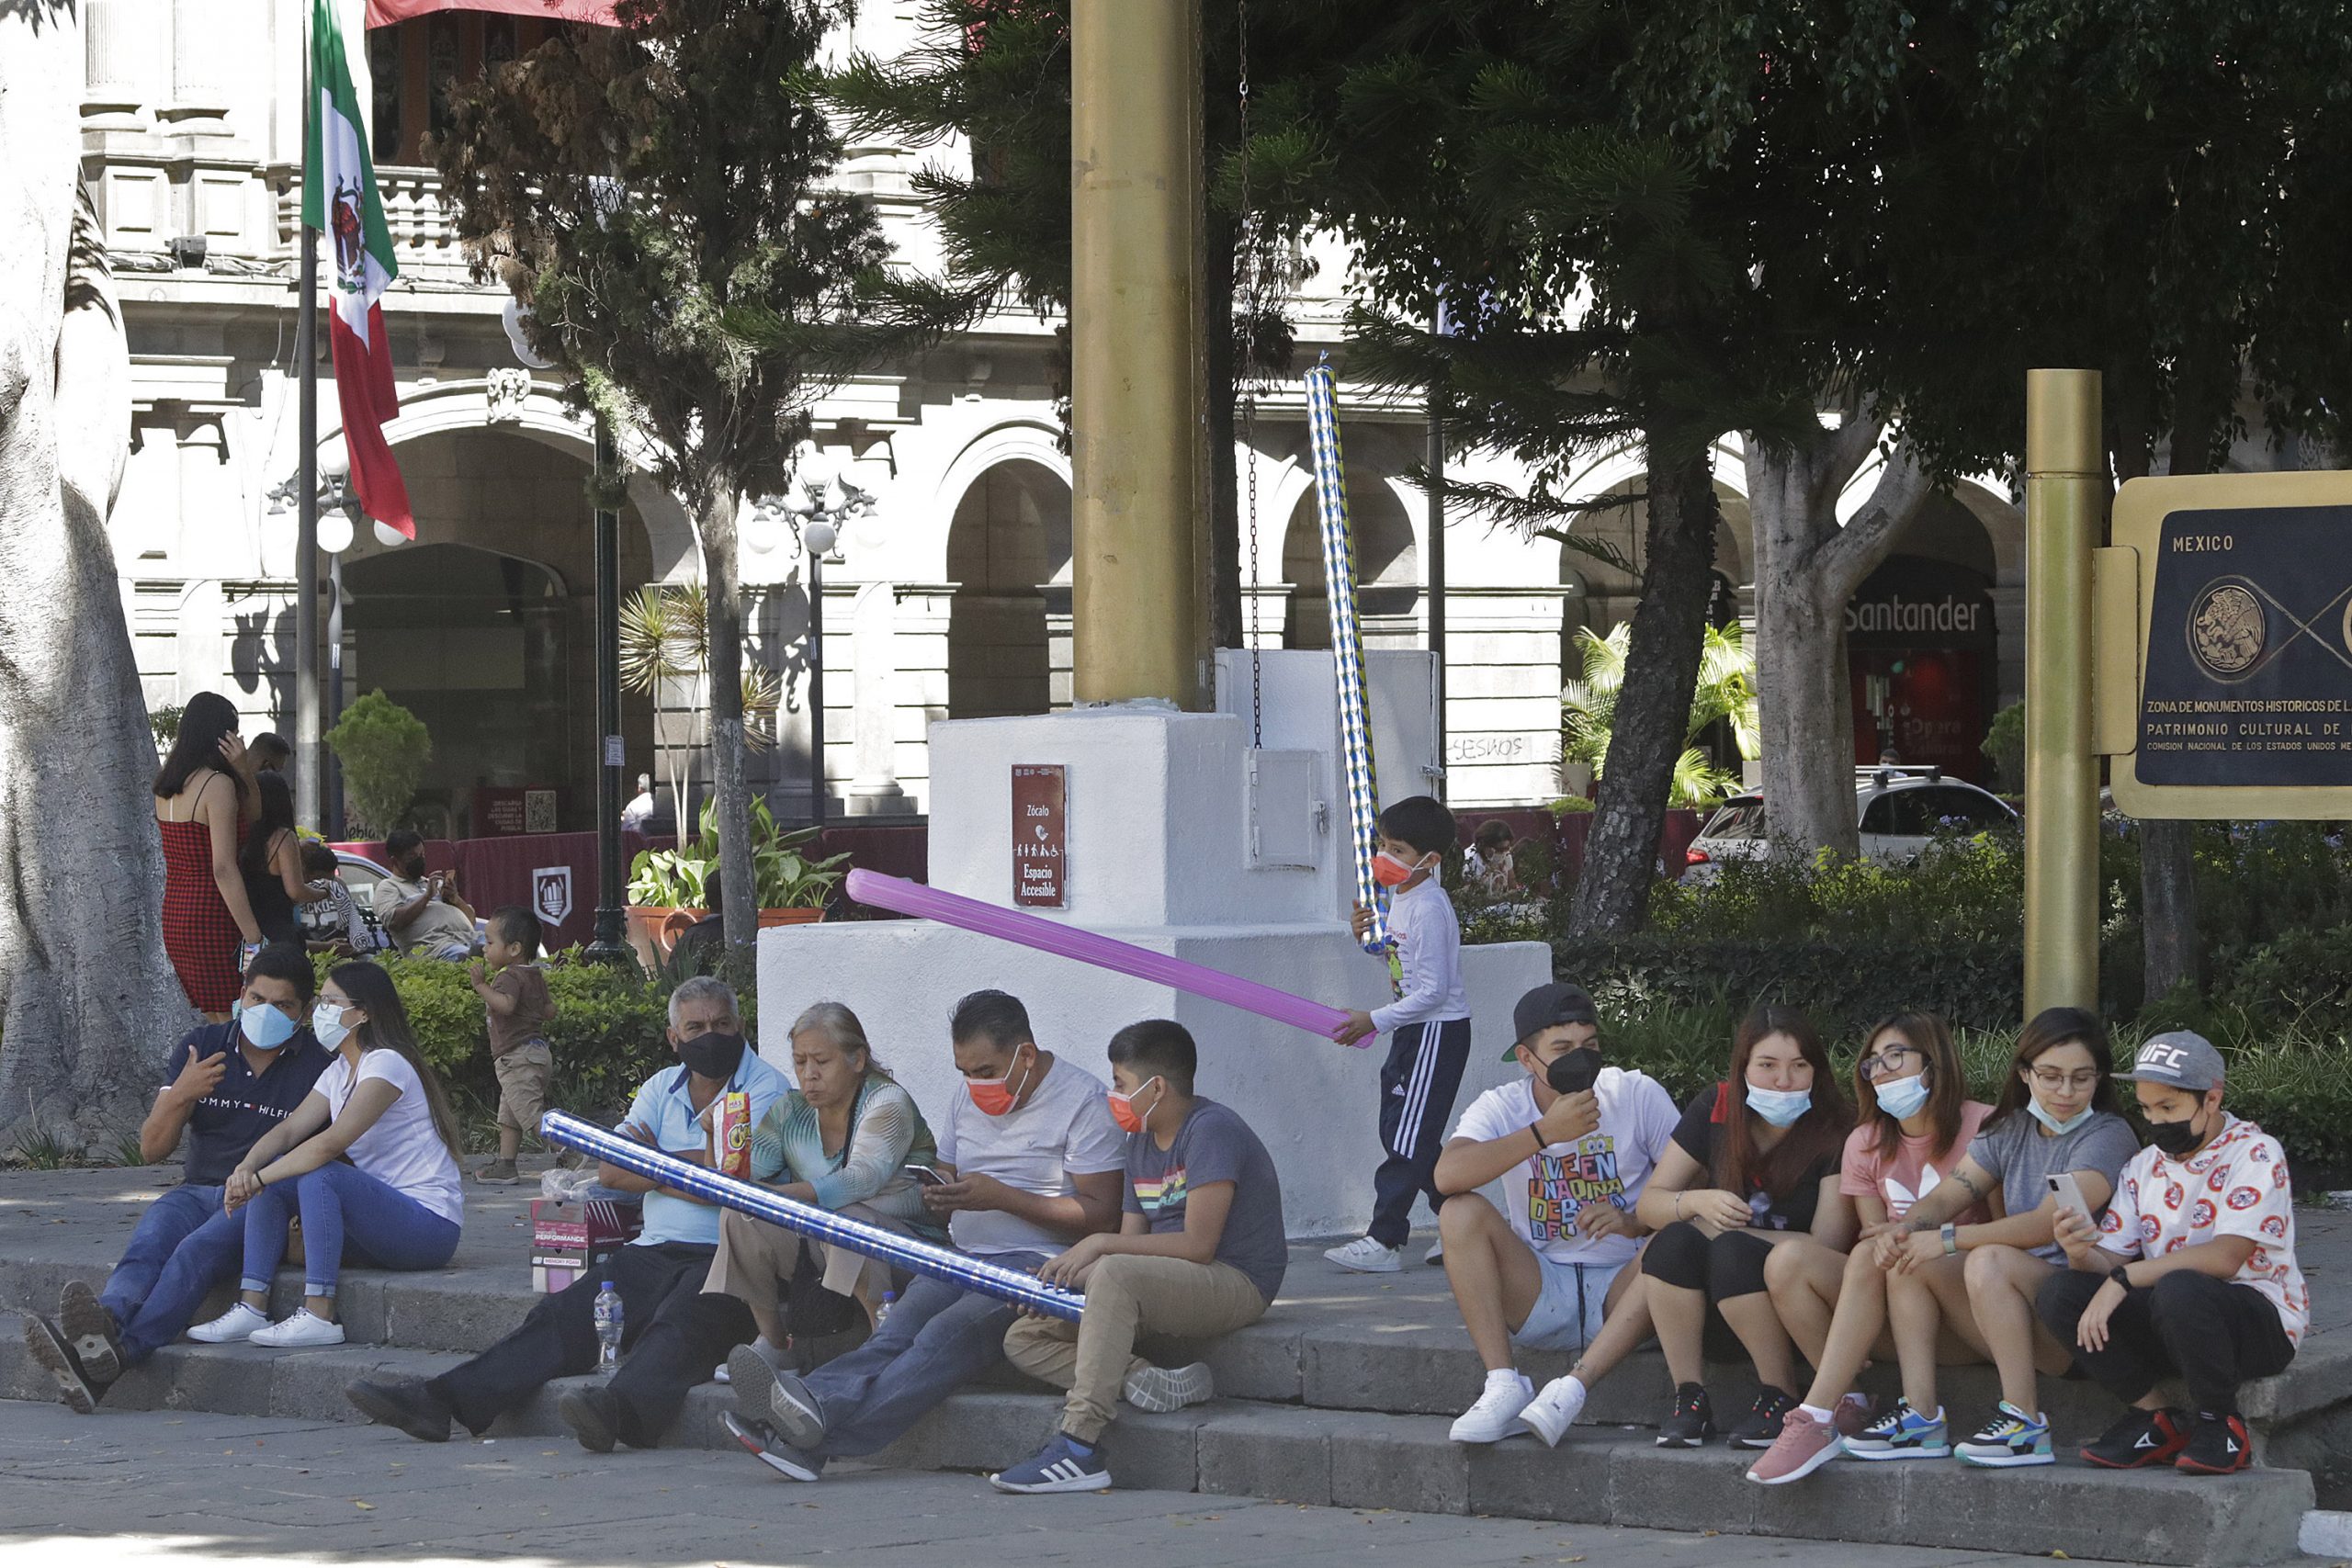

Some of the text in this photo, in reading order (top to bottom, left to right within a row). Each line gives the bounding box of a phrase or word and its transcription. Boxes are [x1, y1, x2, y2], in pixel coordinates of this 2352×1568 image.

[2173, 535, 2233, 552] MEXICO
[1844, 593, 1980, 632] Santander
[2147, 699, 2352, 713] ZONA DE MONUMENTOS HISTORICOS DE L
[2147, 722, 2340, 736] PATRIMONIO CULTURAL DE
[2147, 741, 2183, 751] COMISION
[2188, 741, 2227, 751] NACIONAL
[2232, 741, 2243, 751] DE
[2246, 741, 2262, 751] LOS
[2267, 741, 2302, 751] ESTADOS
[2307, 741, 2336, 751] UNIDOS
[1026, 804, 1049, 817] Zócalo
[1023, 863, 1053, 881] Espacio
[1021, 881, 1056, 897] Accesible
[2139, 1043, 2189, 1068] UFC
[1528, 1151, 1618, 1182] VIVE EN
[1528, 1178, 1574, 1201] UNA
[535, 1234, 585, 1243] PERFORMANCE
